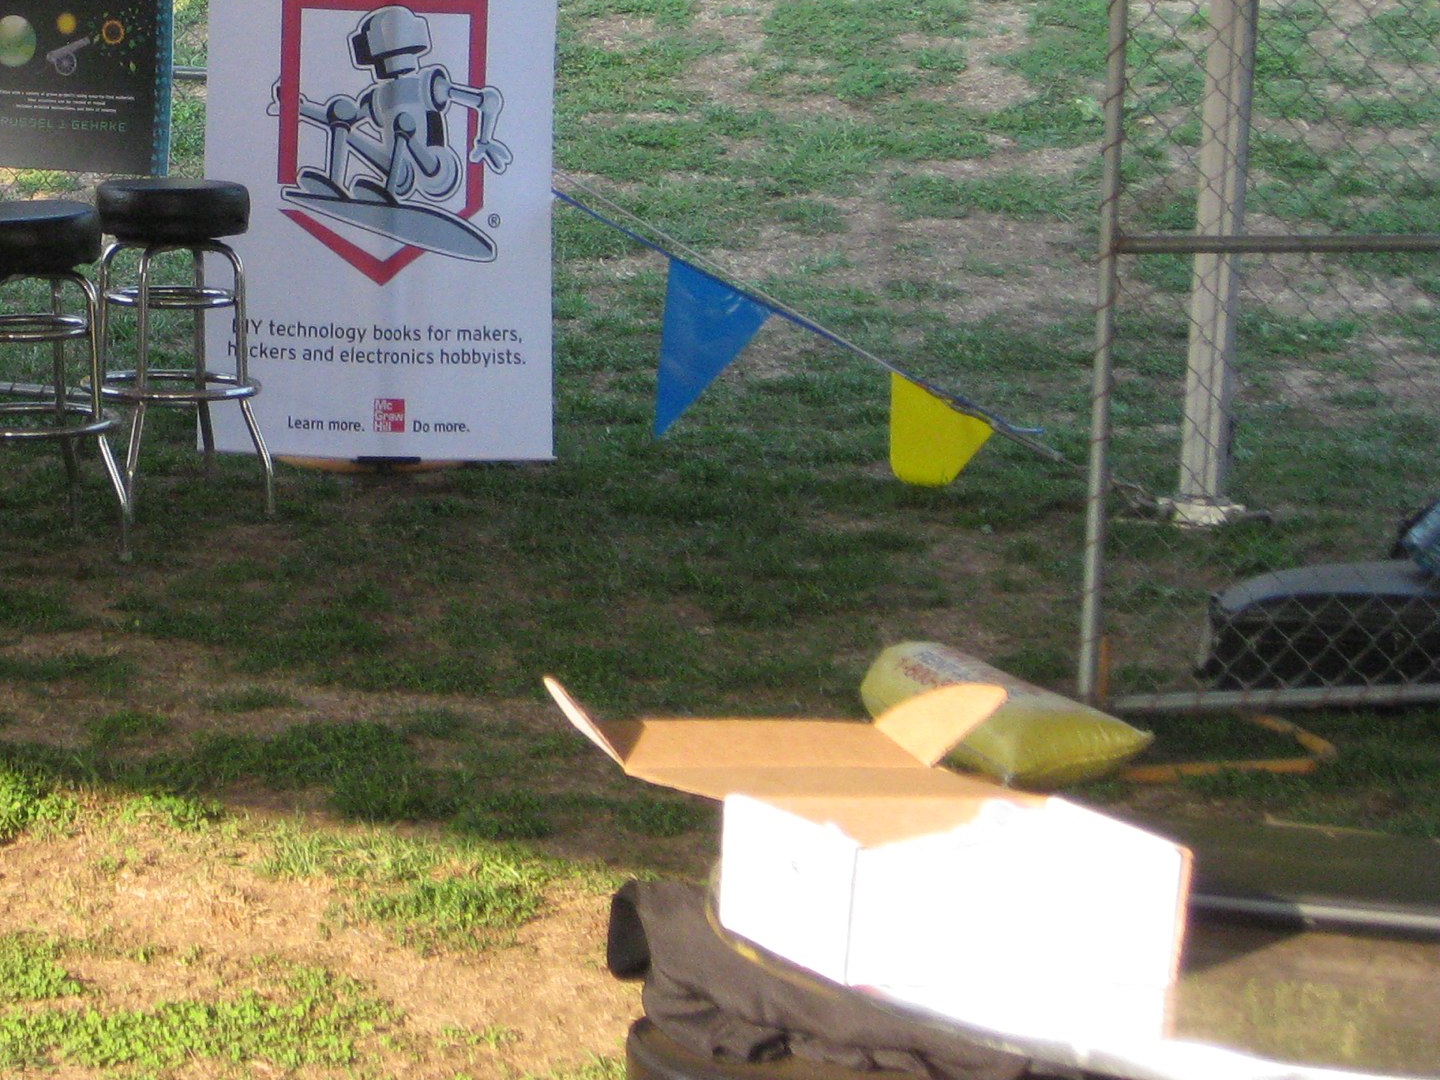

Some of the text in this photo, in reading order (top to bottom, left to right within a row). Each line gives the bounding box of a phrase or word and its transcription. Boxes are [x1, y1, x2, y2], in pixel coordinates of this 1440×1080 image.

[71, 122, 128, 133] GEHRKE
[269, 321, 367, 343] technology
[373, 323, 422, 341] books
[427, 325, 452, 341] for
[456, 326, 523, 343] makers,
[228, 341, 527, 368] hckers and electronics hobbyists.
[374, 399, 393, 410] Mc
[374, 411, 404, 422] Graw
[288, 416, 365, 432] Learn more.
[374, 421, 392, 432] Hill
[413, 420, 470, 432] Do more.
